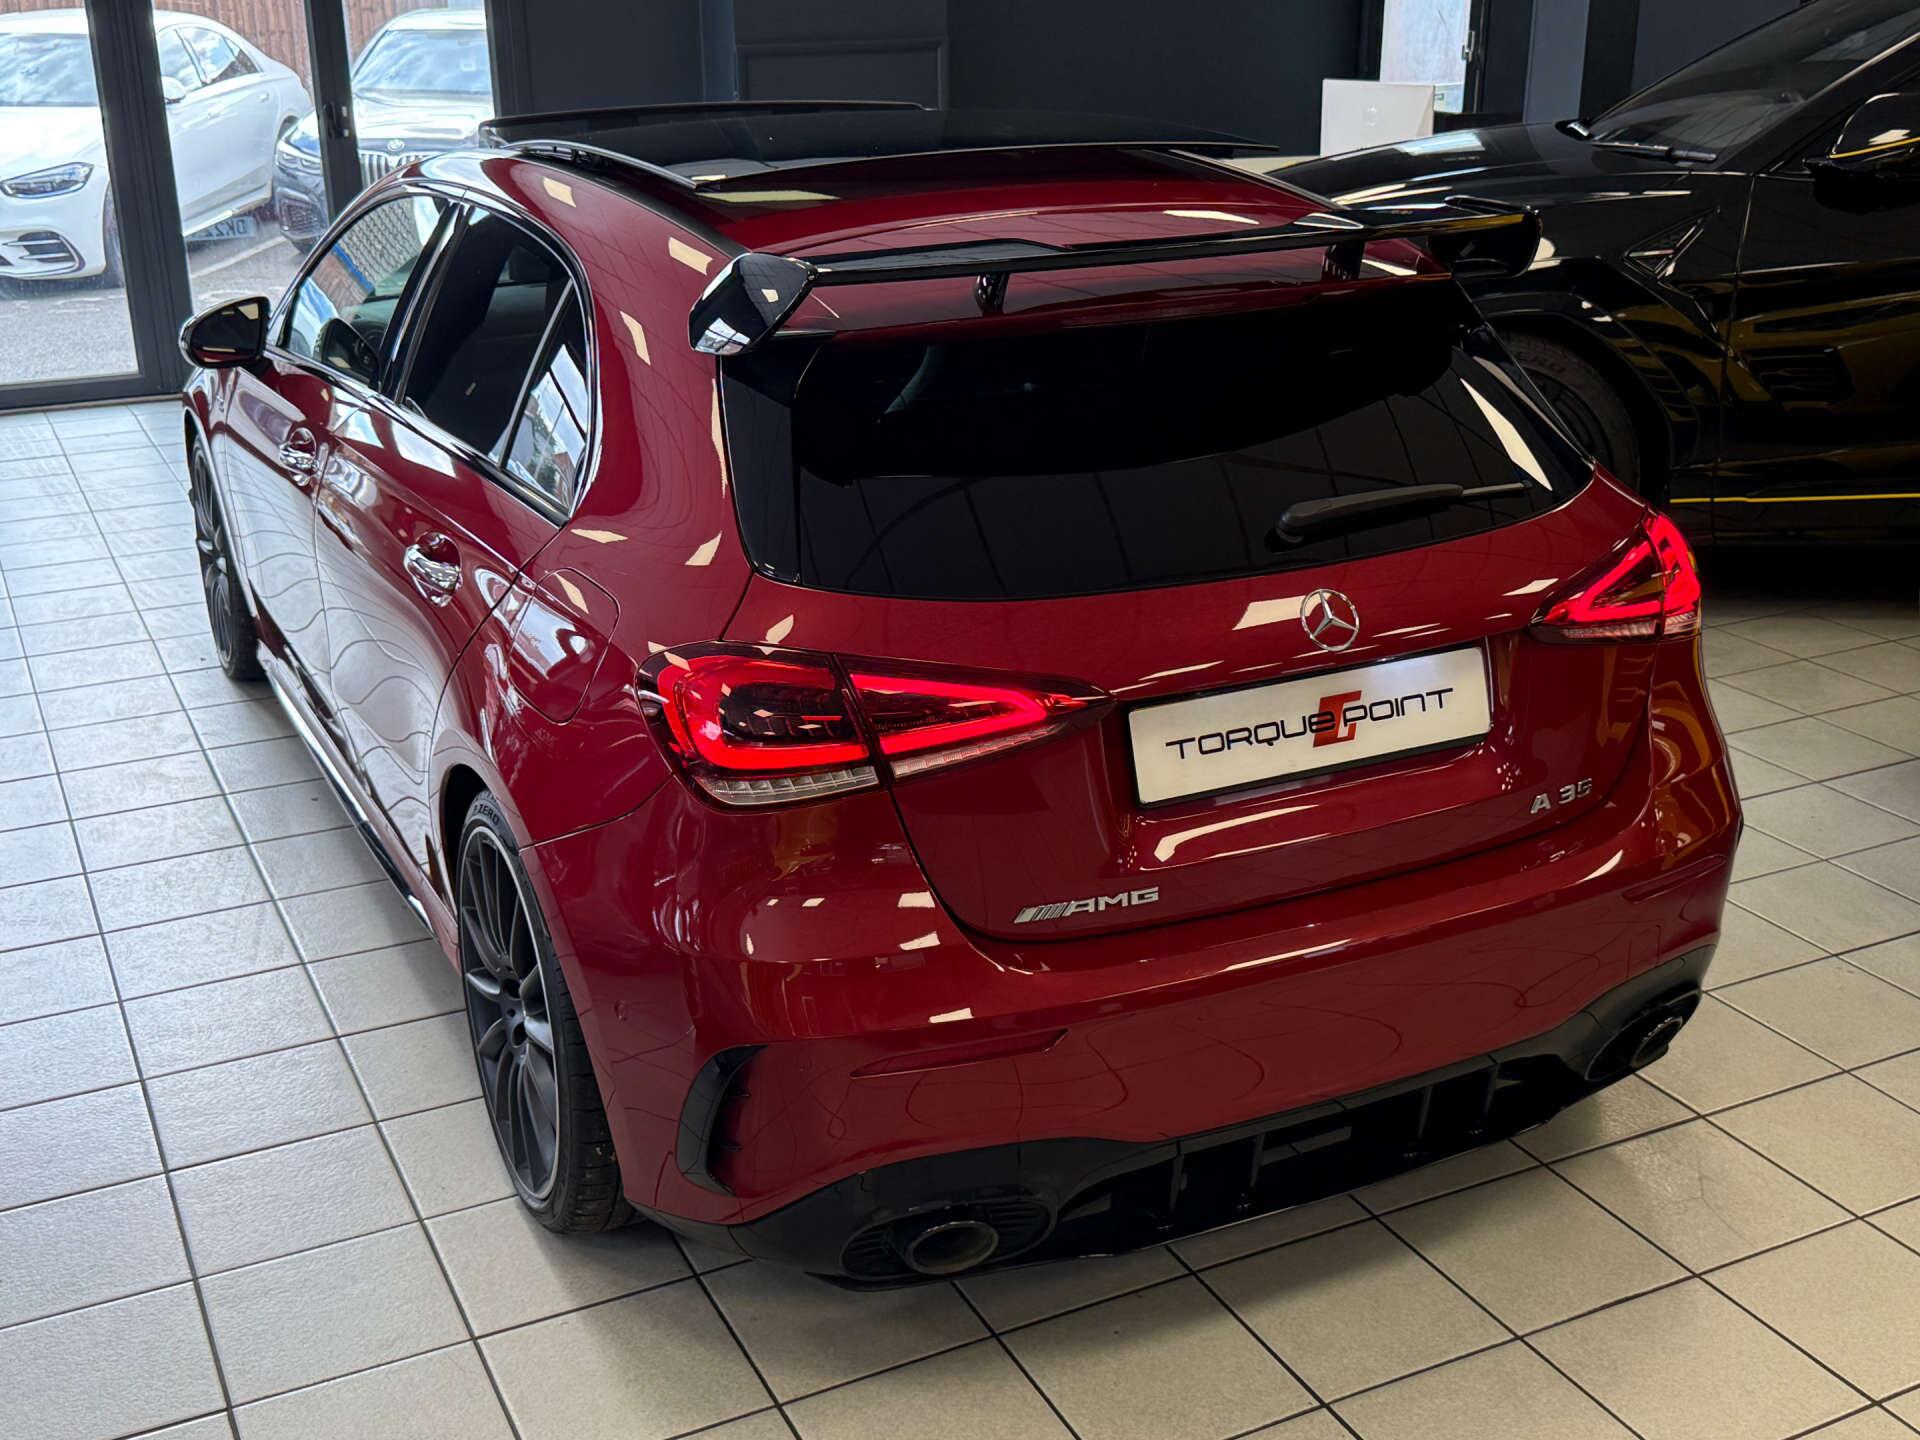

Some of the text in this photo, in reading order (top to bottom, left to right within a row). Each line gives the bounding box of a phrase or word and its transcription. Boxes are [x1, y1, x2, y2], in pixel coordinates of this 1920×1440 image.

[1530, 778, 1592, 814] A 35
[478, 803, 500, 826] ZERO
[1064, 886, 1159, 916] AMG
